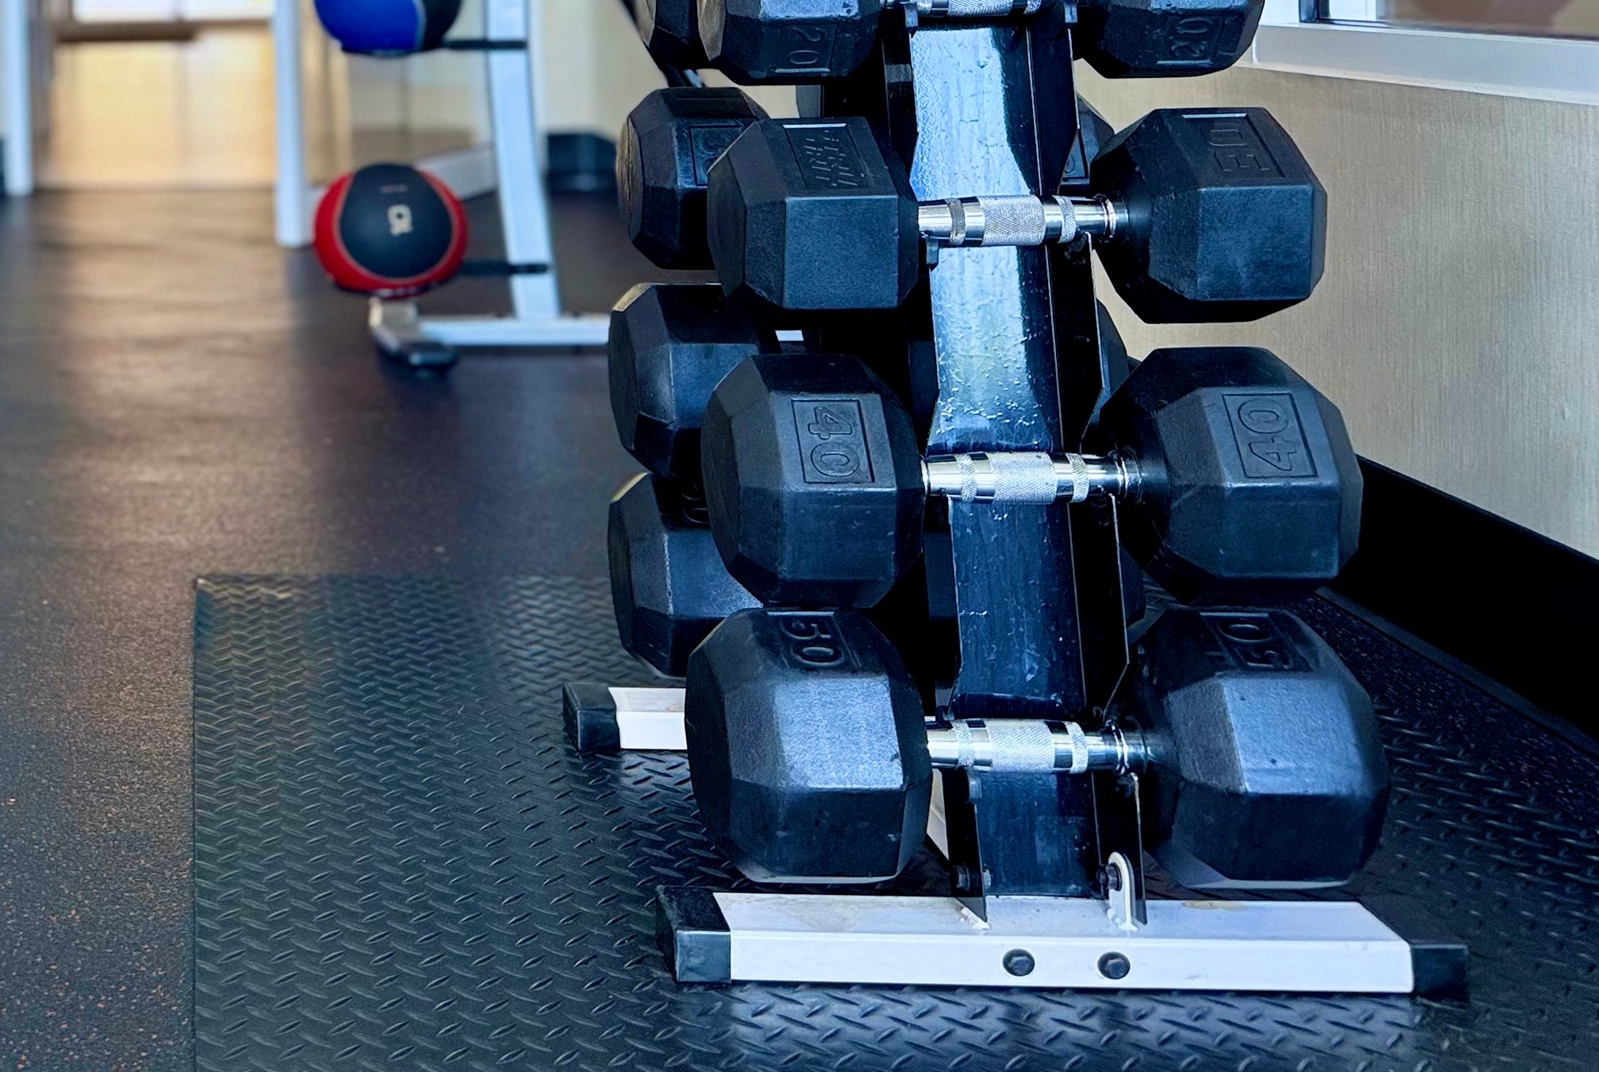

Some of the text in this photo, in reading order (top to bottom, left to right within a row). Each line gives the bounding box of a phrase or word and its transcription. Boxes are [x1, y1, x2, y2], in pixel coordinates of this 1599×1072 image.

[785, 25, 826, 66] 20
[807, 406, 860, 478] 40
[1236, 398, 1299, 472] 40
[780, 617, 845, 666] 50
[1214, 617, 1294, 670] 50
